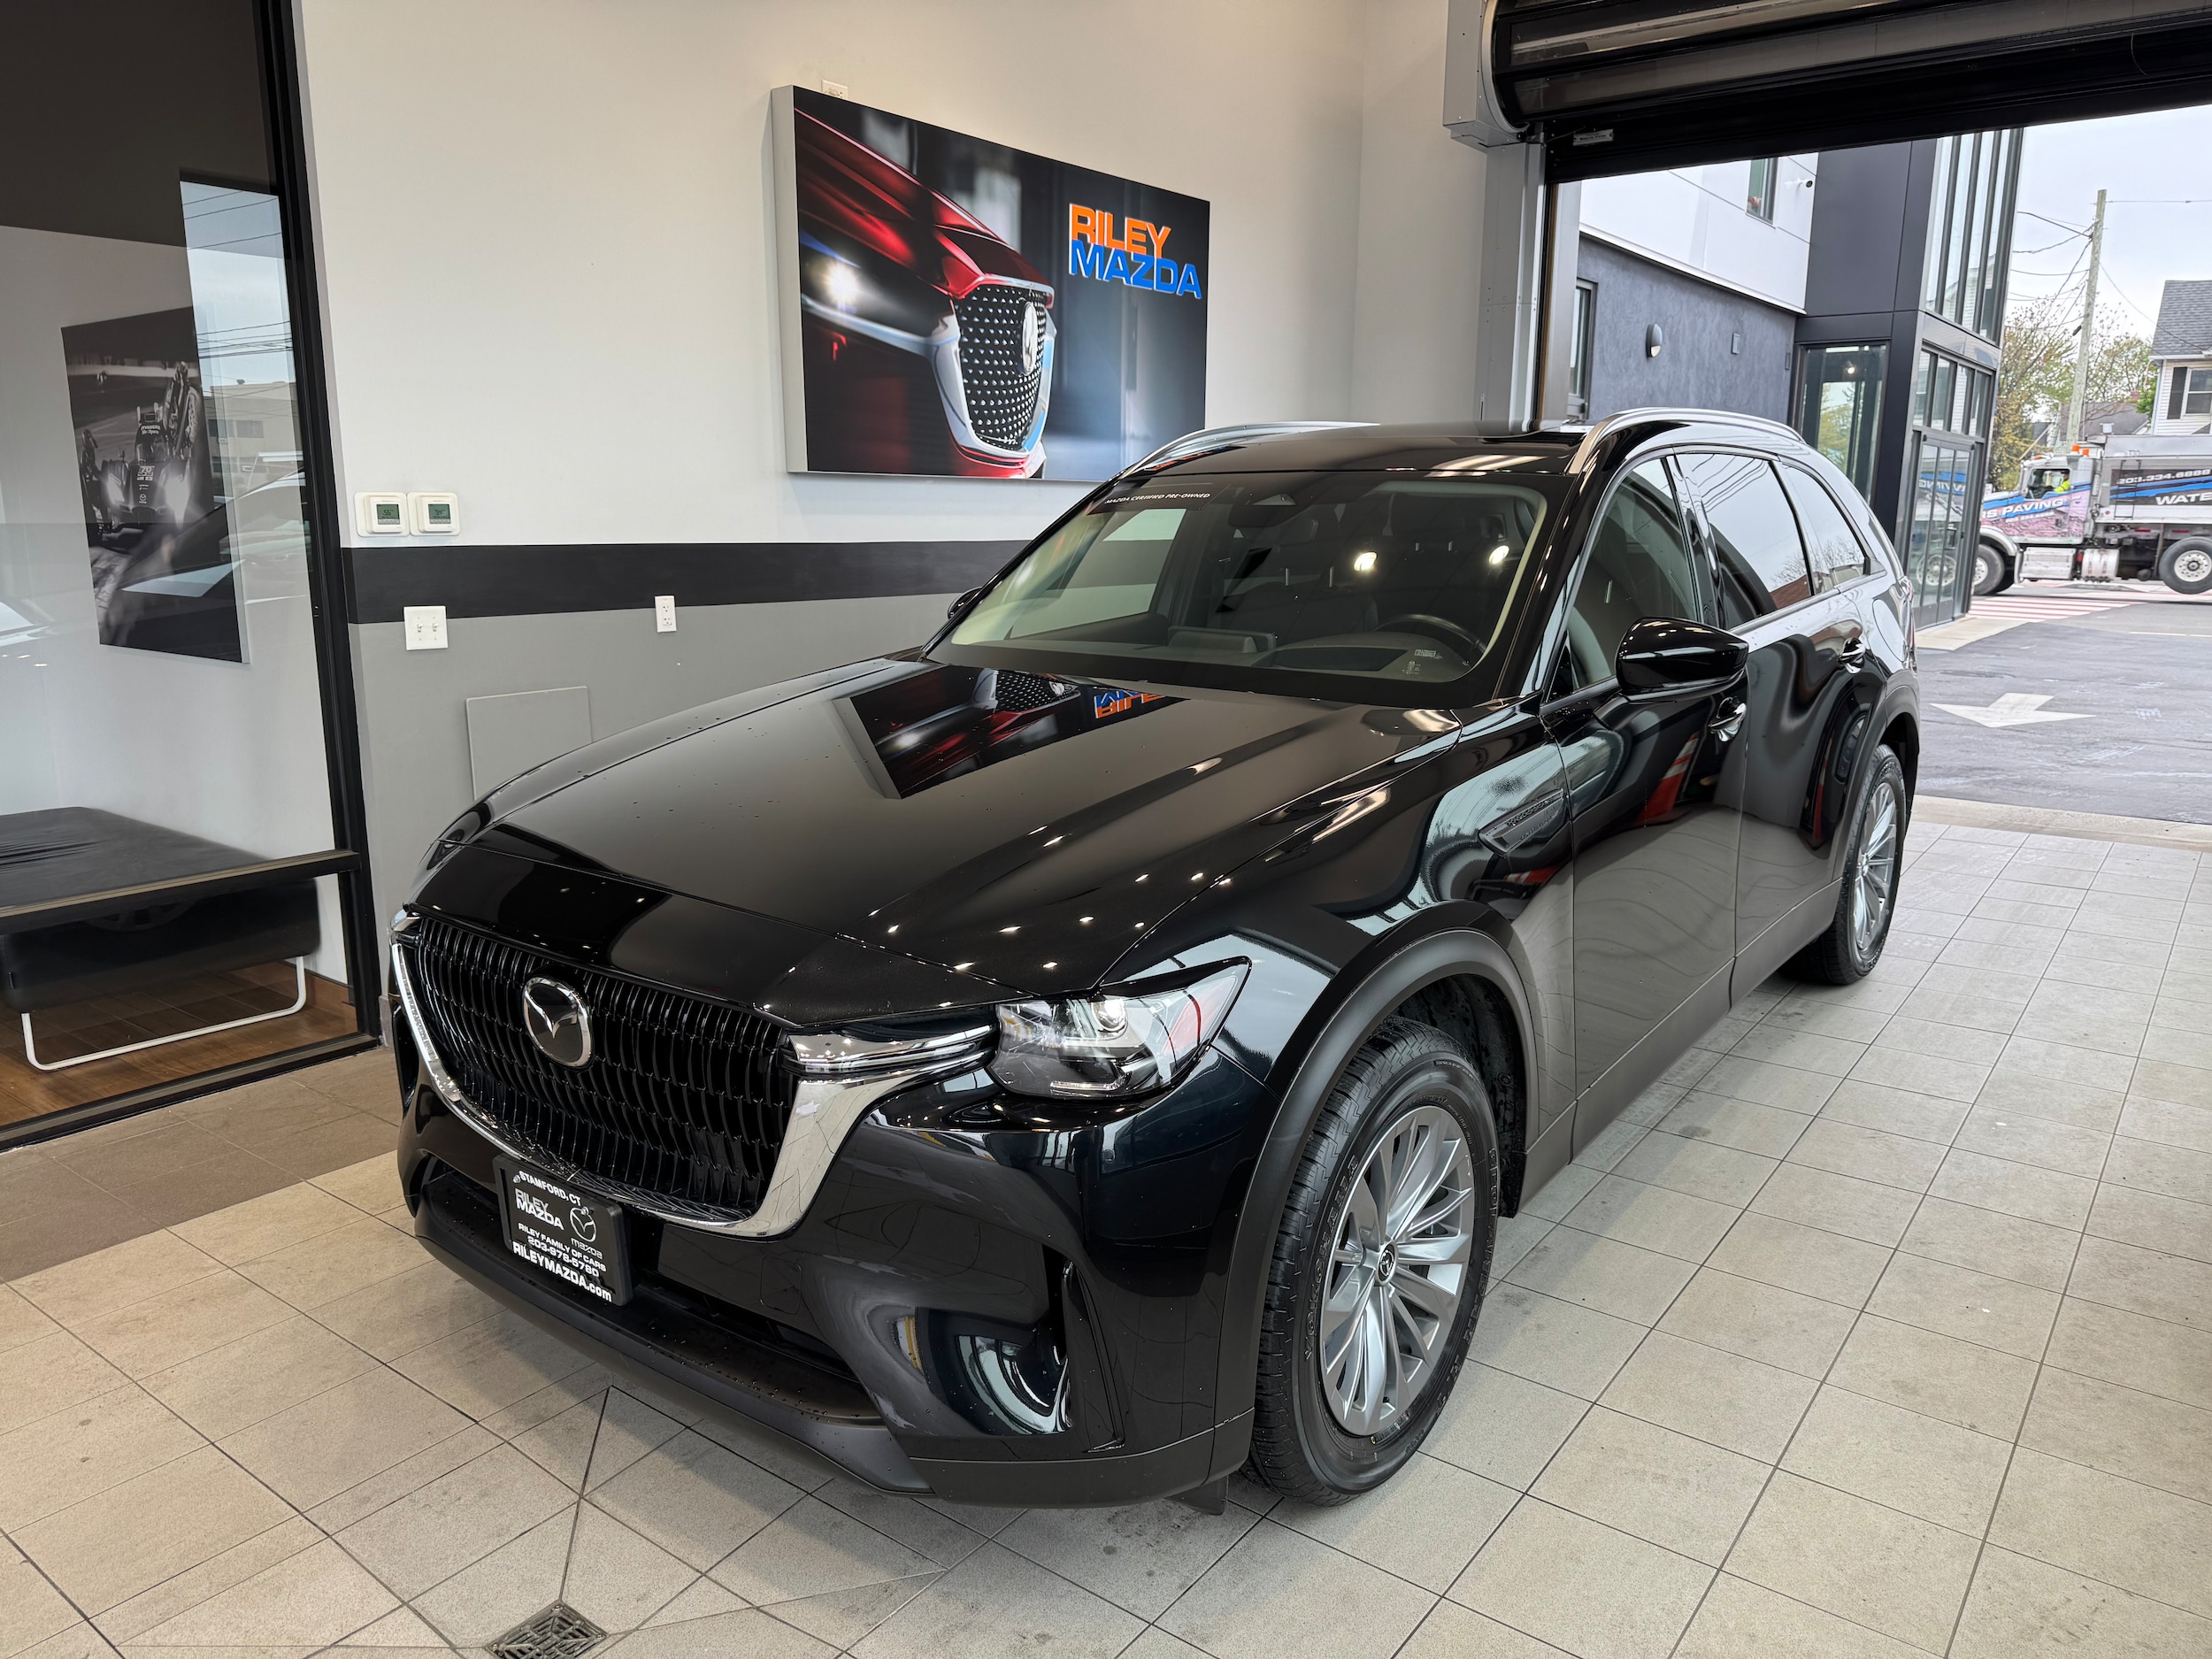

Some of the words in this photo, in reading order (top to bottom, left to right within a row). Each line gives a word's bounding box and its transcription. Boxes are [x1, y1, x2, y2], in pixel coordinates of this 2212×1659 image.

[1069, 203, 1171, 258] RILEY
[1069, 239, 1202, 299] MAZDA
[2002, 498, 2063, 516] PAVING
[515, 1188, 549, 1212] RILEY
[516, 1198, 565, 1231] MAZDA
[512, 1240, 612, 1302] RILEYMAZDA.com
[518, 1223, 541, 1239] RILEY
[541, 1233, 571, 1254] FAMILY
[572, 1248, 584, 1259] OF
[584, 1252, 607, 1272] CARS
[527, 1235, 600, 1278] 203-978-5780
[1304, 1154, 1358, 1360] YOKOHAMA
